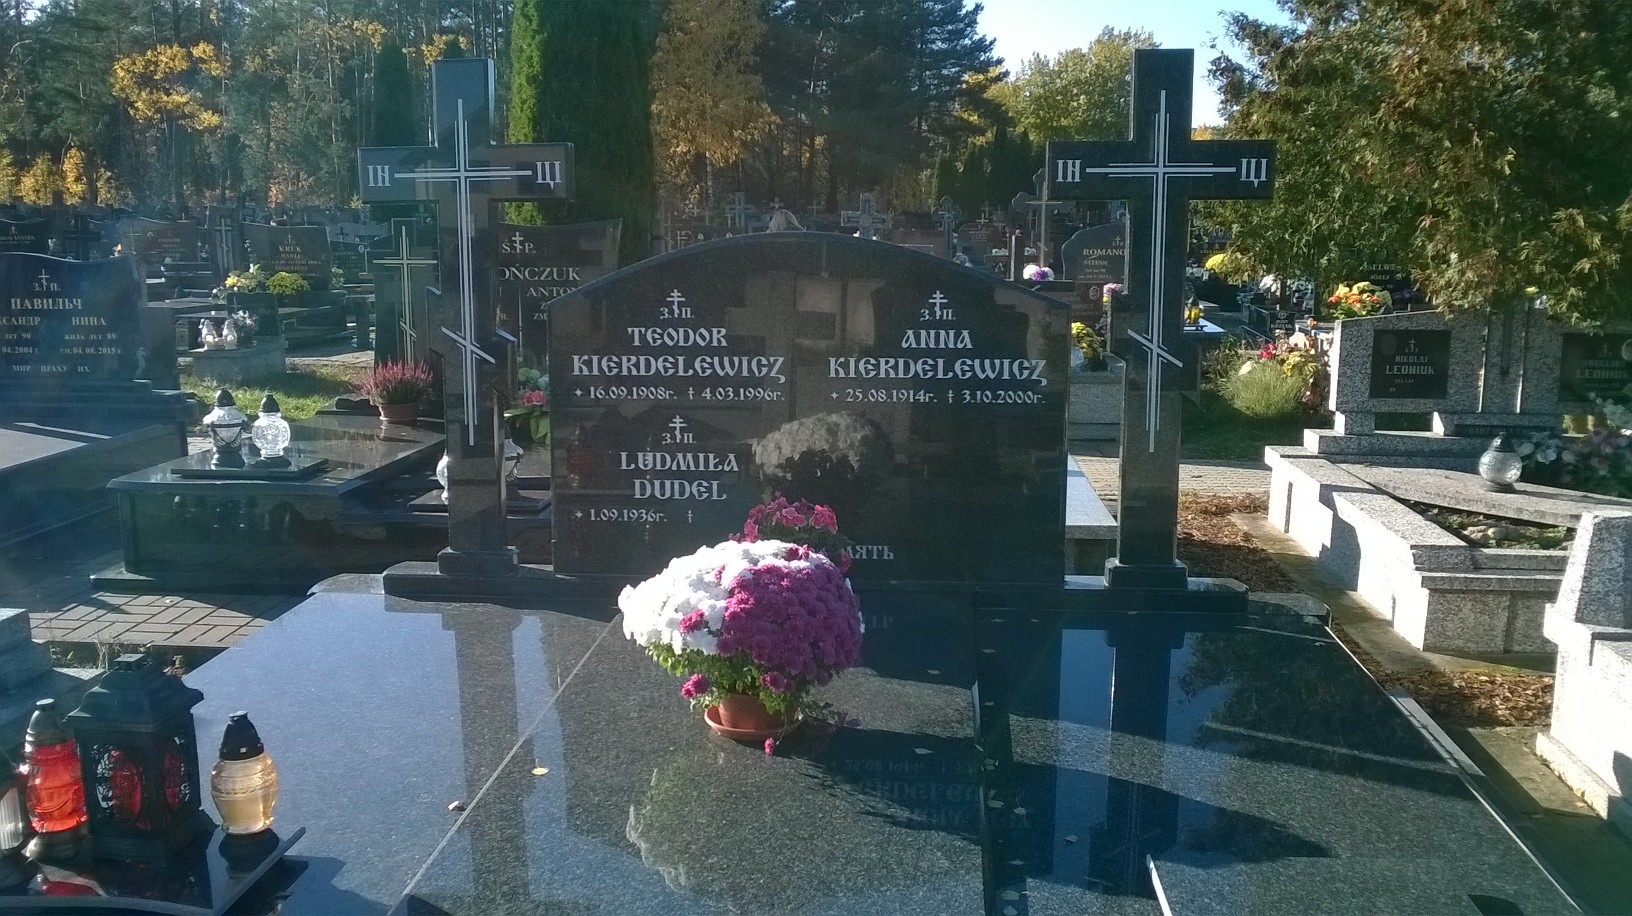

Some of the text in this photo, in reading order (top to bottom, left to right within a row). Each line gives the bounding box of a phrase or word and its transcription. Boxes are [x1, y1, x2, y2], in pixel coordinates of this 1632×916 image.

[10, 297, 83, 310] ПАВИЛЬЧ
[71, 316, 107, 327] НИНА
[627, 327, 729, 348] TEODOR
[901, 329, 975, 350] ANNA
[571, 354, 787, 384] KIERDELEWICZ
[827, 356, 1049, 387] KIERDELEWICZ
[1385, 365, 1435, 375] LEONIUK
[619, 451, 740, 472] LUDMIŁA
[632, 478, 728, 501] DUDEL
